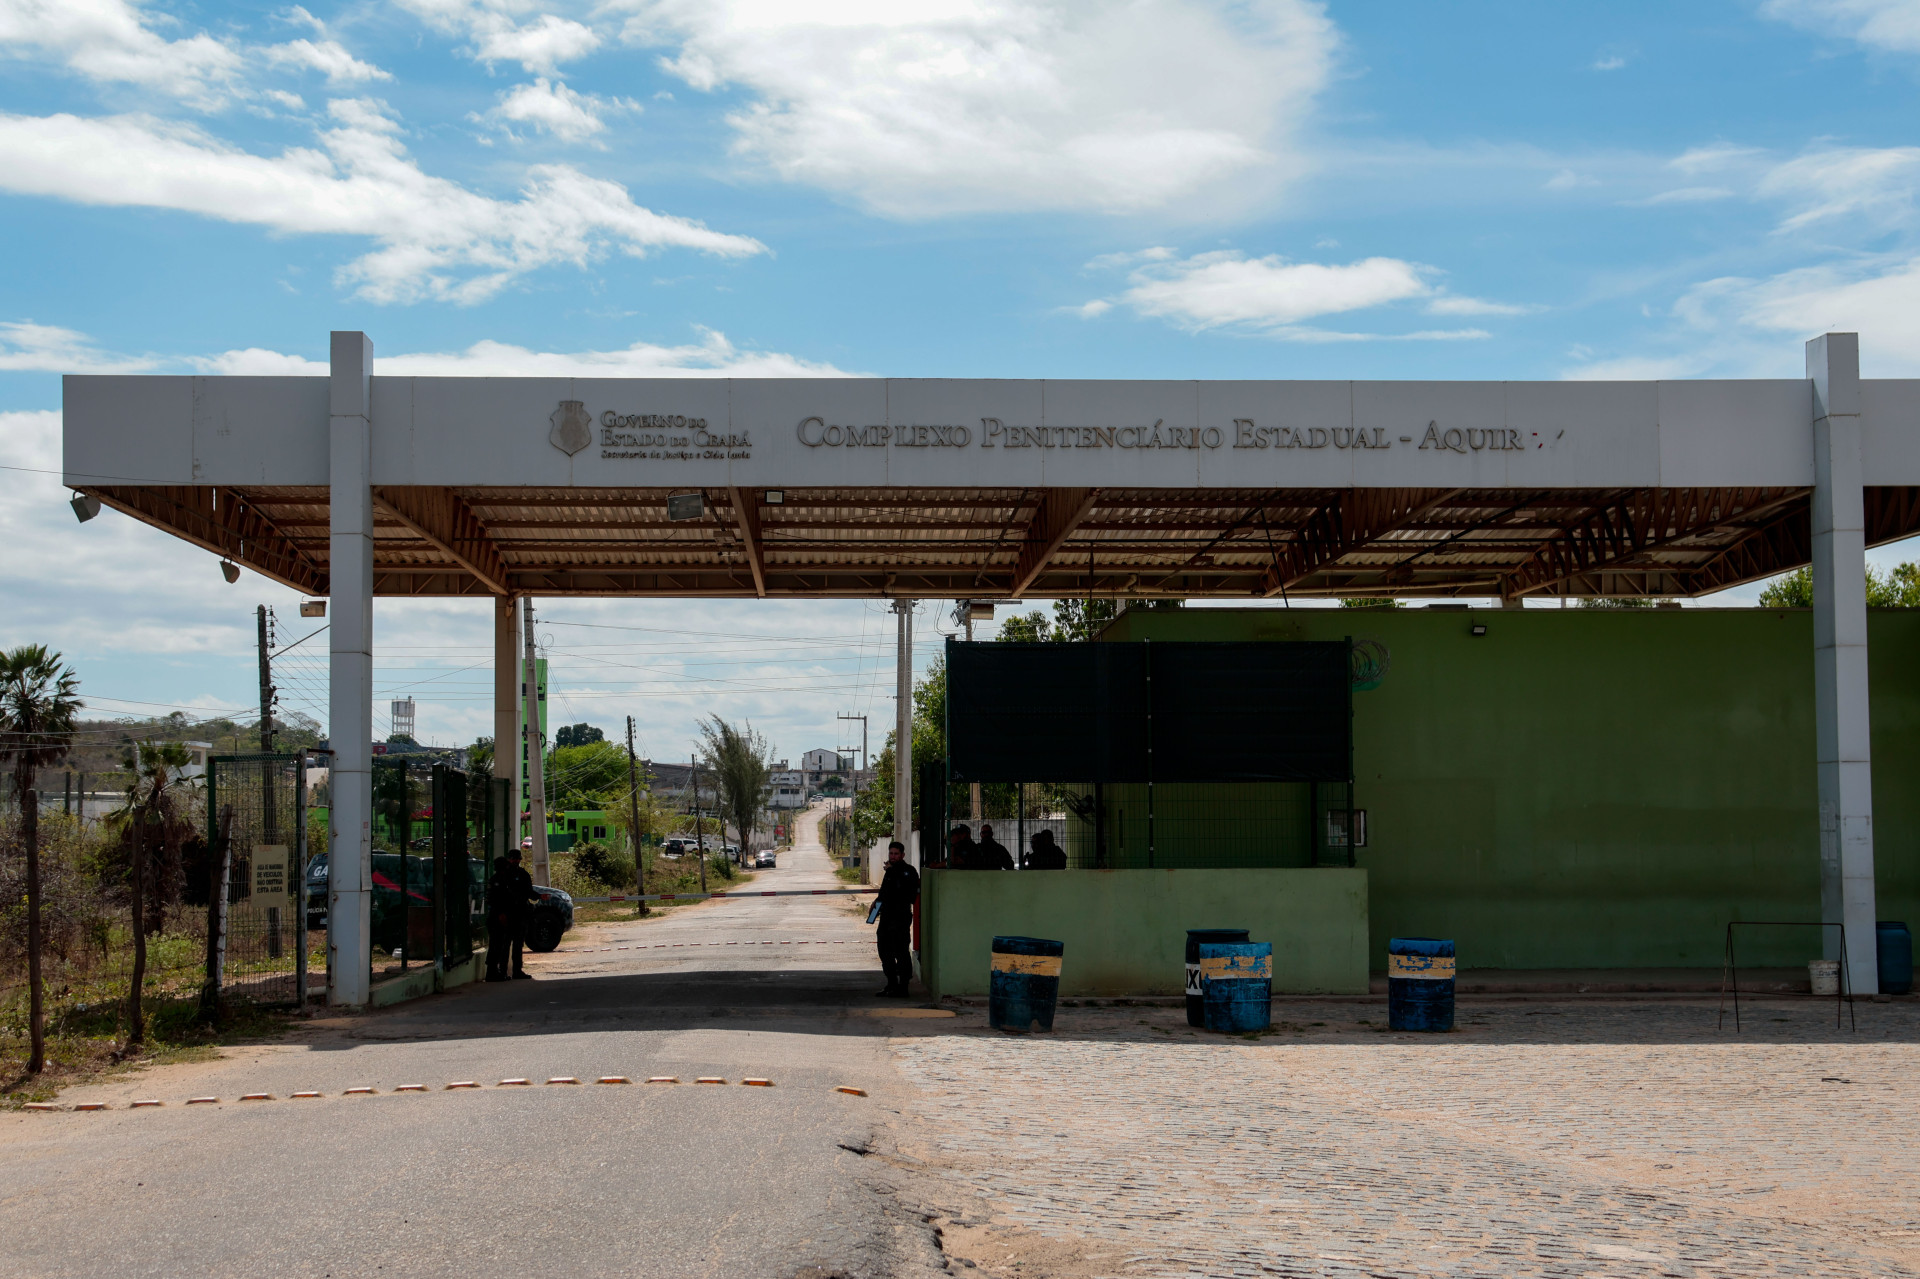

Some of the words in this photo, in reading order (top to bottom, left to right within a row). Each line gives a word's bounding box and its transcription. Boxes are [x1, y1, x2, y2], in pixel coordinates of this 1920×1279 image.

[600, 429, 668, 447] ESTADO
[670, 436, 690, 447] DO
[693, 430, 752, 448] CEARÁ
[797, 416, 972, 447] COMPLEXO
[980, 418, 1225, 450] PENITENCIÁRIO
[1233, 418, 1391, 449] ESTADUAL
